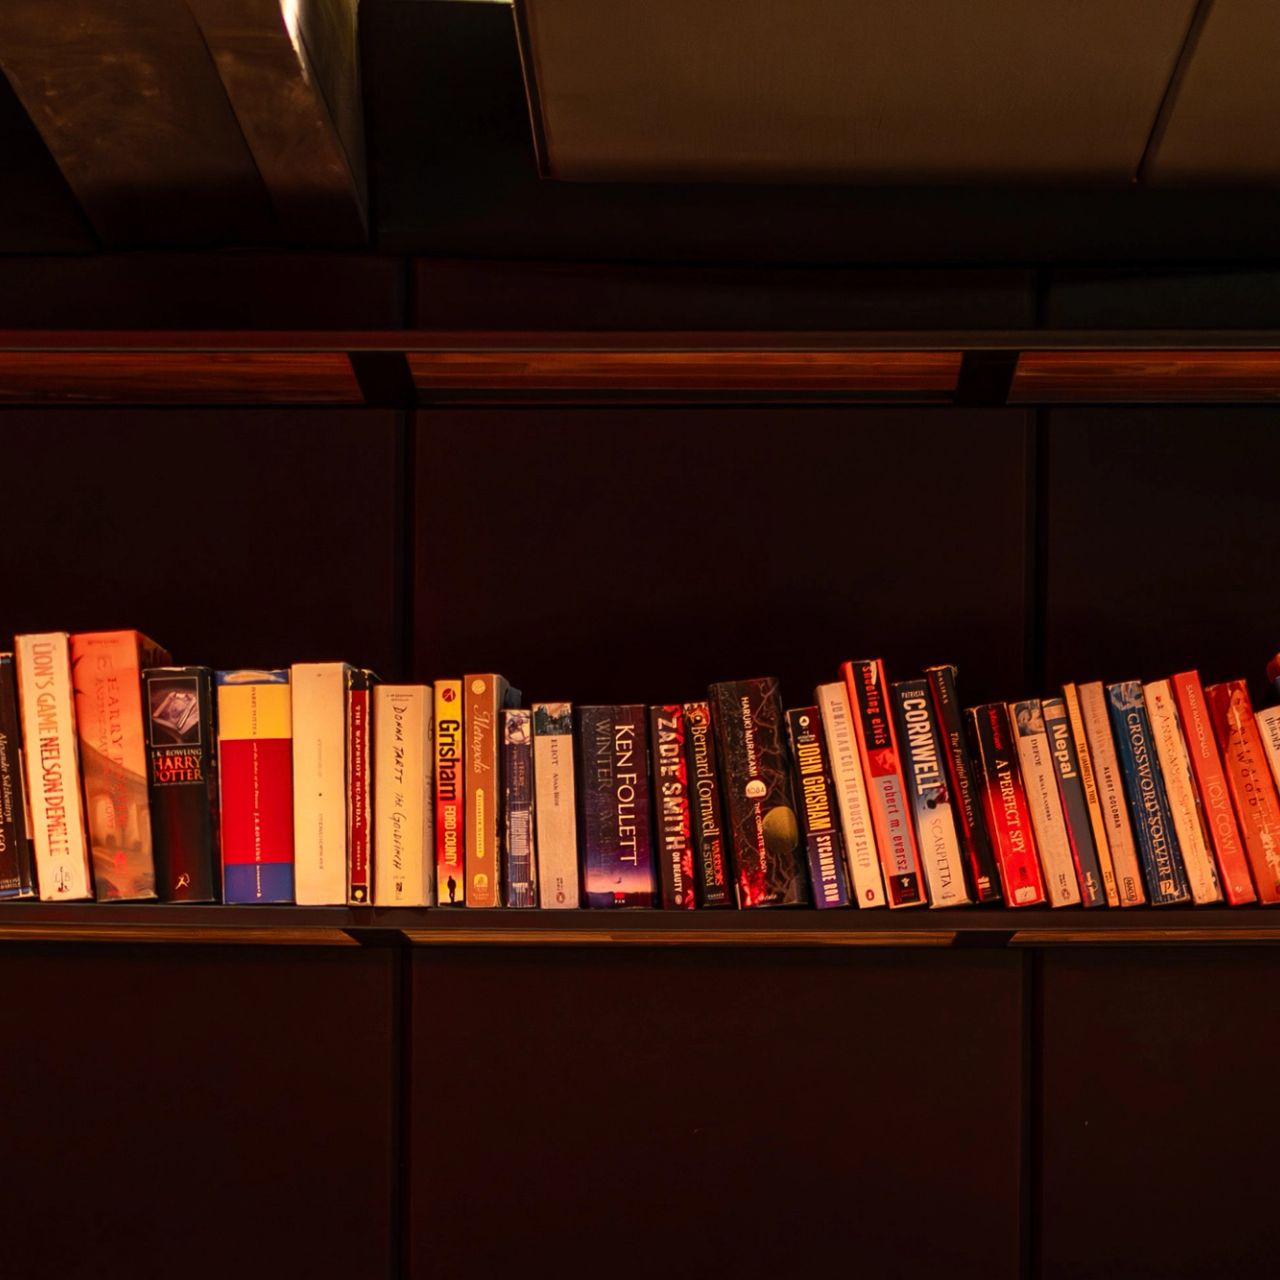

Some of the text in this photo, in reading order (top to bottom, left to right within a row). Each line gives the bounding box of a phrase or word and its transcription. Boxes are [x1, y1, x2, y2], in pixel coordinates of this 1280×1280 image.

[439, 720, 460, 801] Grisham
[473, 705, 490, 773] Metropolis
[903, 699, 940, 794] CORNWELL
[1053, 724, 1076, 779] Nepal
[153, 769, 204, 783] POTTER
[615, 725, 637, 866] KEN FOLLETT
[691, 726, 719, 836] Bernard Cornwell
[797, 743, 831, 830] JOHN GRISHAM
[1078, 743, 1086, 753] THE
[1087, 790, 1096, 804] TREE
[1127, 713, 1171, 875] CROSSWORD SOLVER
[753, 803, 761, 814] THE
[755, 816, 764, 847] COMPLETE
[882, 780, 908, 871] robert m. eversz
[703, 852, 713, 886] STORM
[816, 836, 839, 901] SYCAMORE ROW
[931, 818, 950, 887] SCARPETTA
